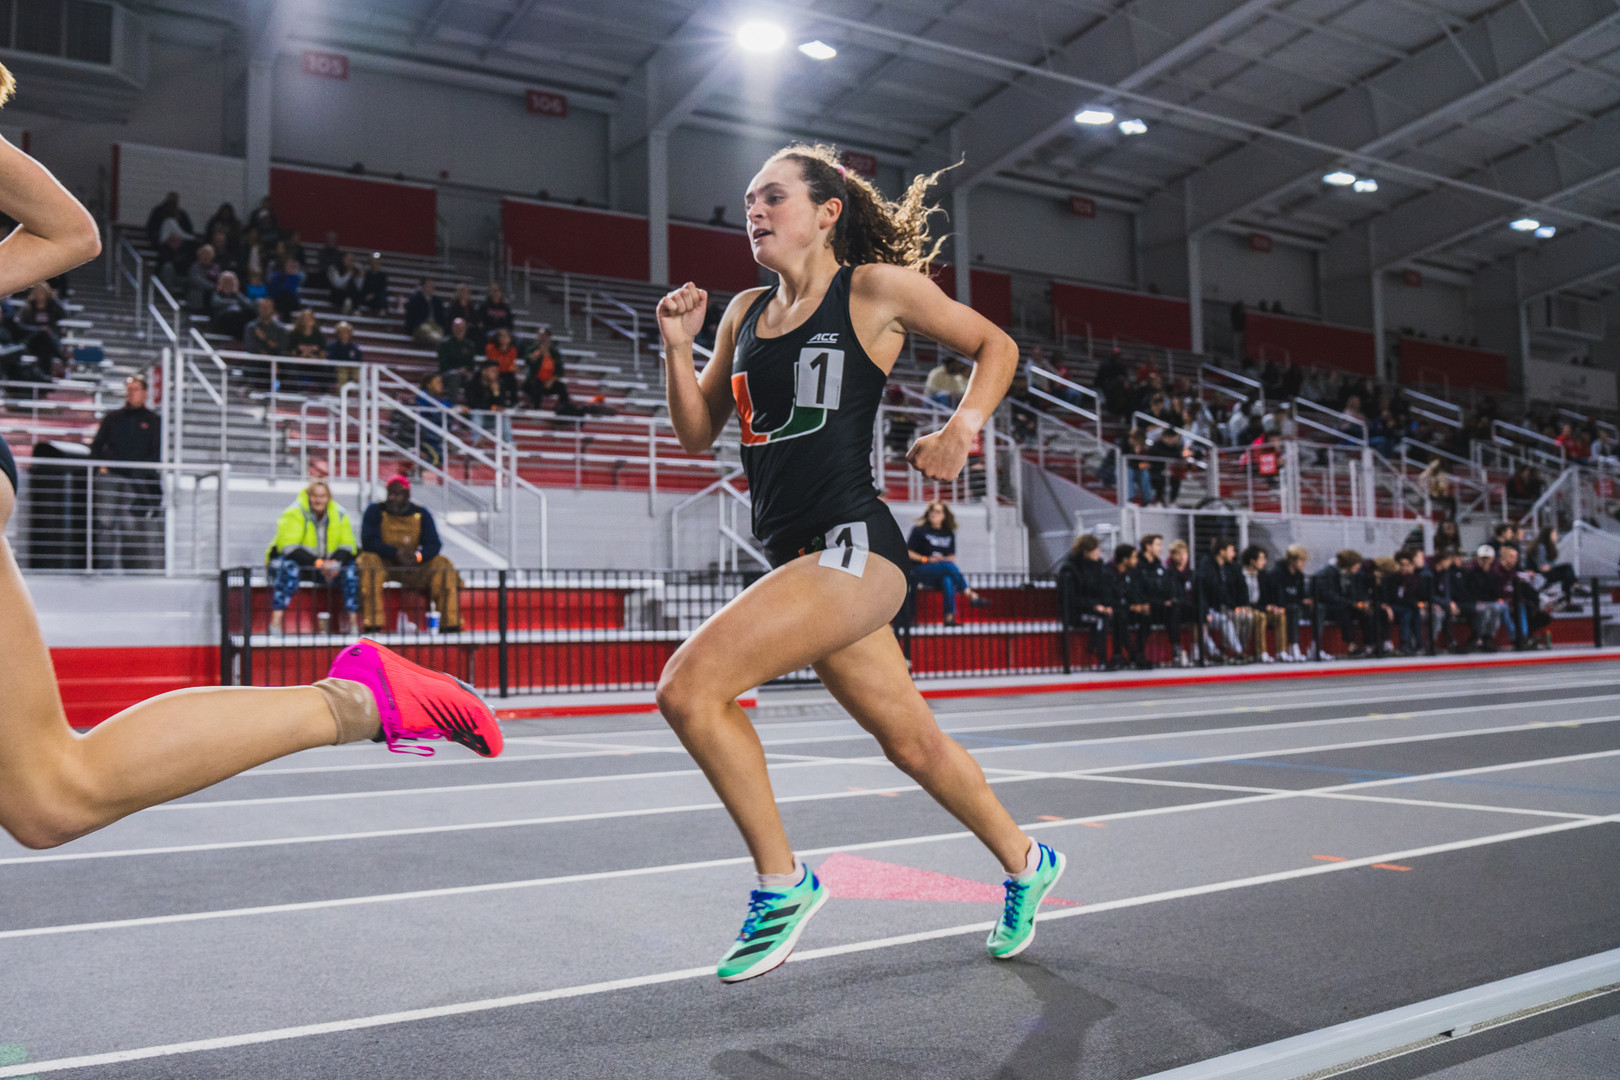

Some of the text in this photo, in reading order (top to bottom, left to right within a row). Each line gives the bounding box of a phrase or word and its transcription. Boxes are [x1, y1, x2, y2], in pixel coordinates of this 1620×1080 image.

[809, 332, 840, 342] ACC
[809, 352, 829, 405] 1
[834, 526, 854, 569] 1
